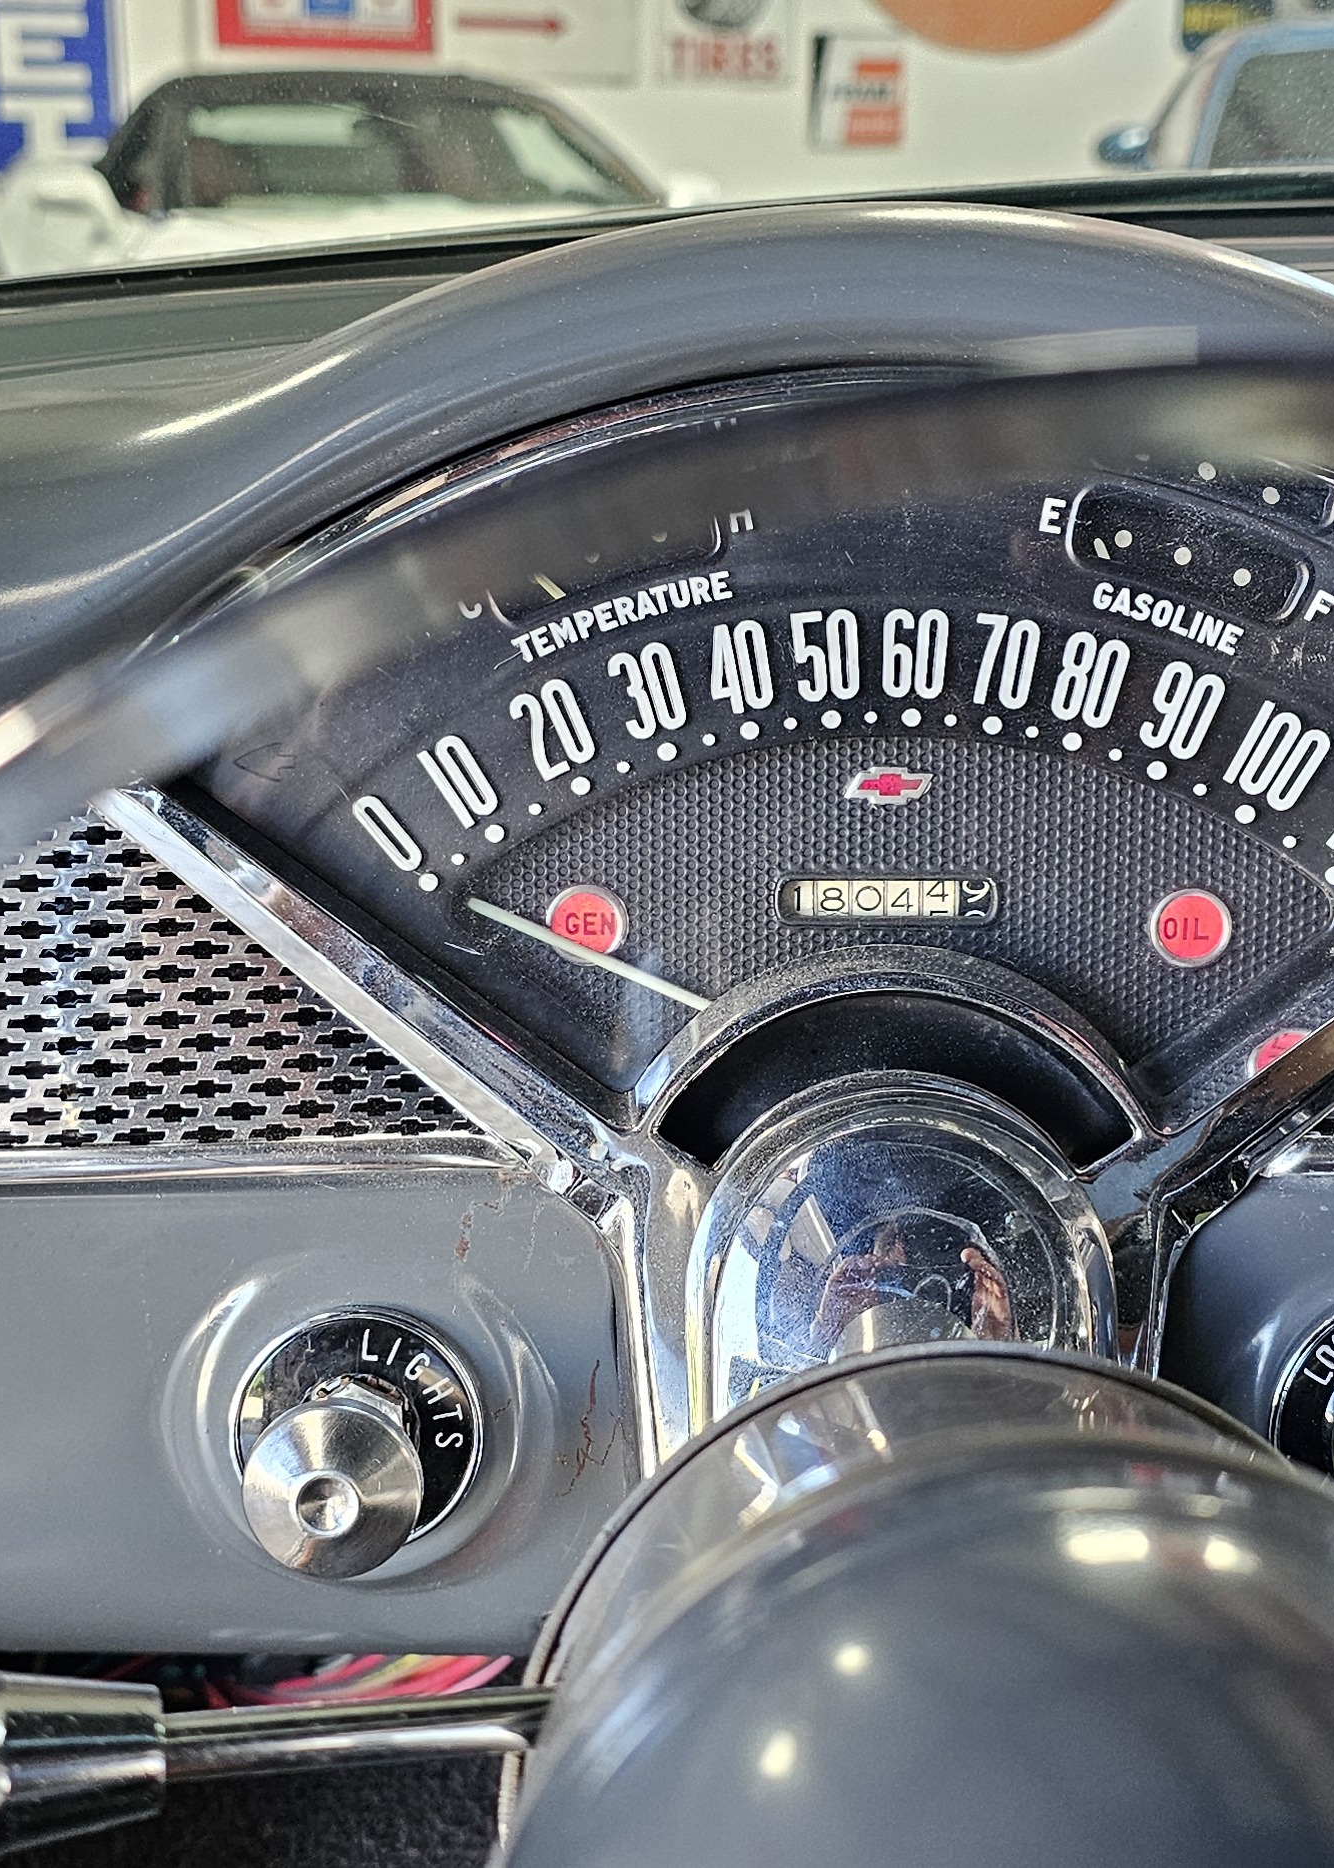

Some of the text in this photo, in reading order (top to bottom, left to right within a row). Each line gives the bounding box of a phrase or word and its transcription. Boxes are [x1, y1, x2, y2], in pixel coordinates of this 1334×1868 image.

[1038, 497, 1067, 535] E
[510, 570, 734, 663] TEMPERATURE
[1092, 581, 1246, 657] GASOLINE
[352, 795, 423, 872] 0
[416, 735, 499, 829] 10
[509, 678, 596, 782] 20
[607, 642, 687, 740] 30
[710, 619, 774, 715] 40
[789, 608, 861, 702] 50
[881, 608, 950, 700] 60
[973, 612, 1041, 710] 70
[1050, 631, 1131, 729] 80
[1139, 661, 1226, 760] 90
[1222, 699, 1331, 812] 100
[565, 912, 617, 936] GEN
[1162, 916, 1210, 942] OIL
[361, 1328, 464, 1450] LIGHTS
